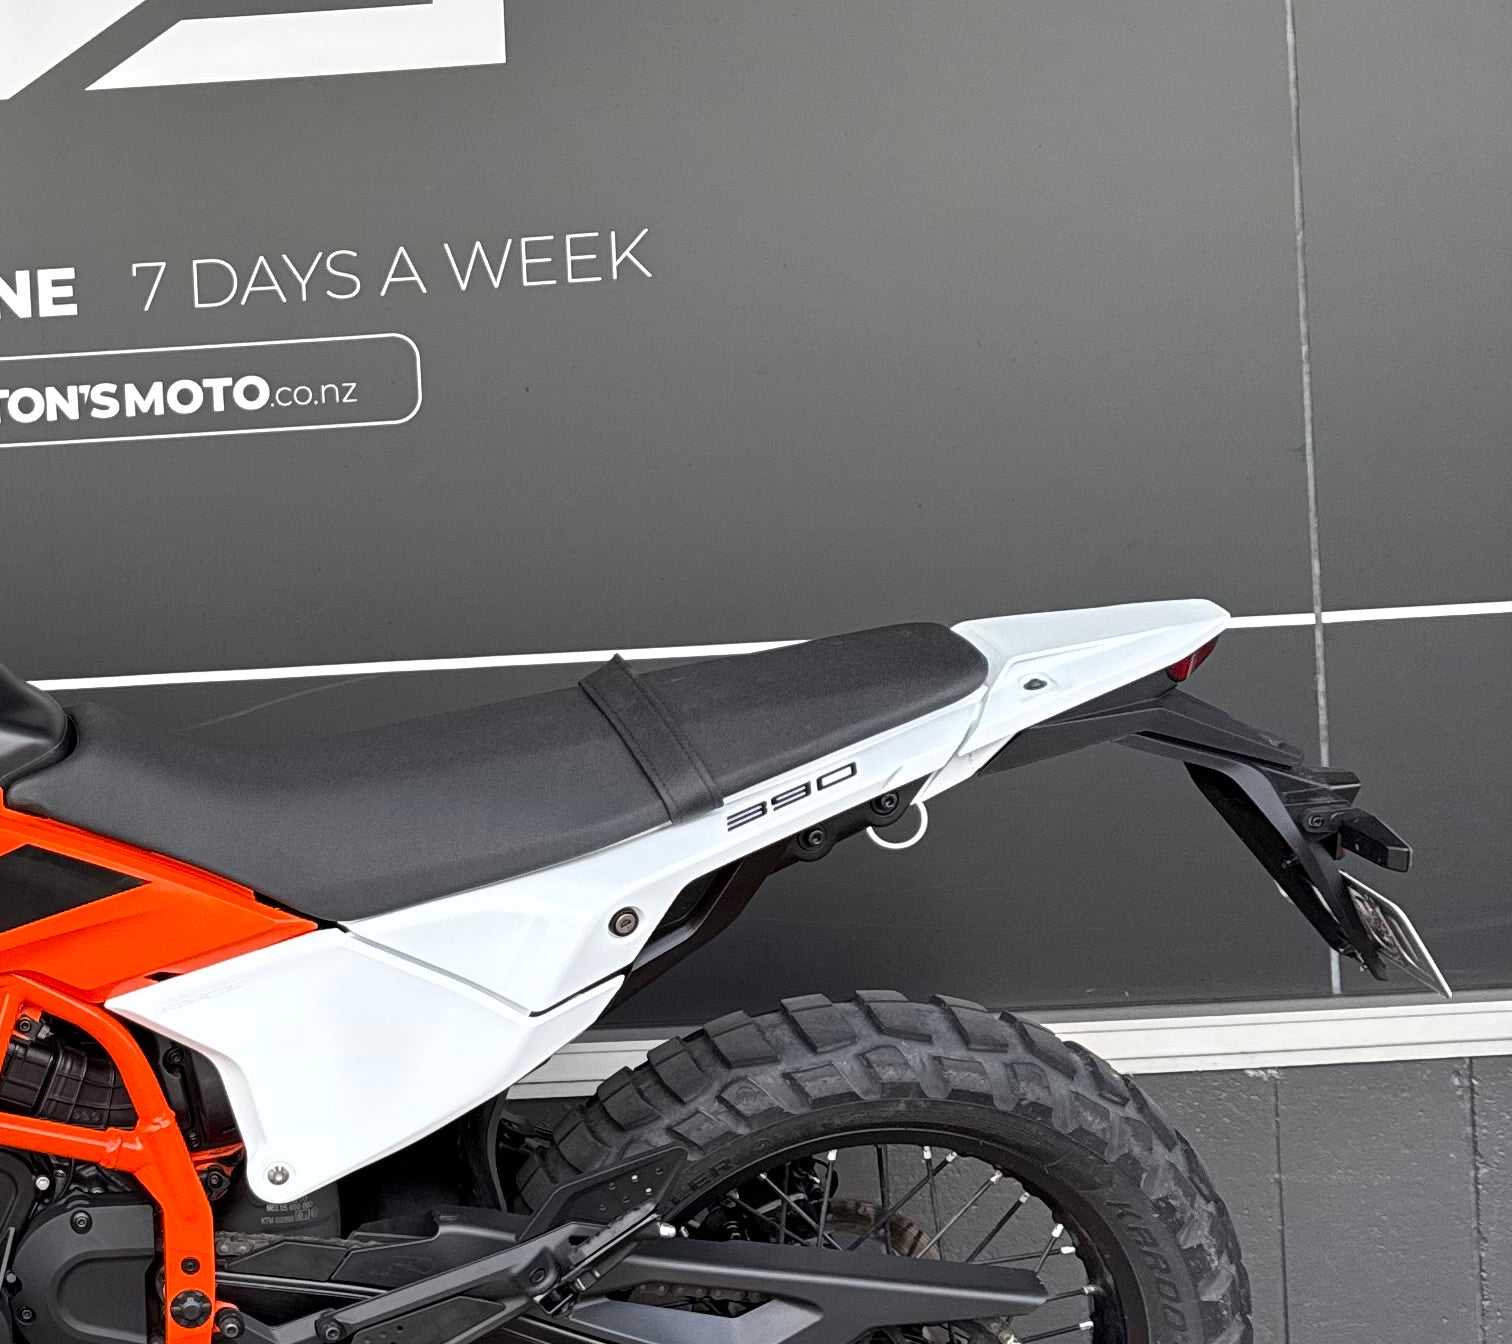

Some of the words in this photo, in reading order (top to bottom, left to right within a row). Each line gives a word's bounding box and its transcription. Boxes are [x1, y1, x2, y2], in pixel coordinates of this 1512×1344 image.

[131, 261, 167, 312] 7
[192, 249, 362, 309] DAYS
[379, 245, 428, 297] A
[443, 227, 653, 291] WEEK
[726, 760, 859, 832] 390
